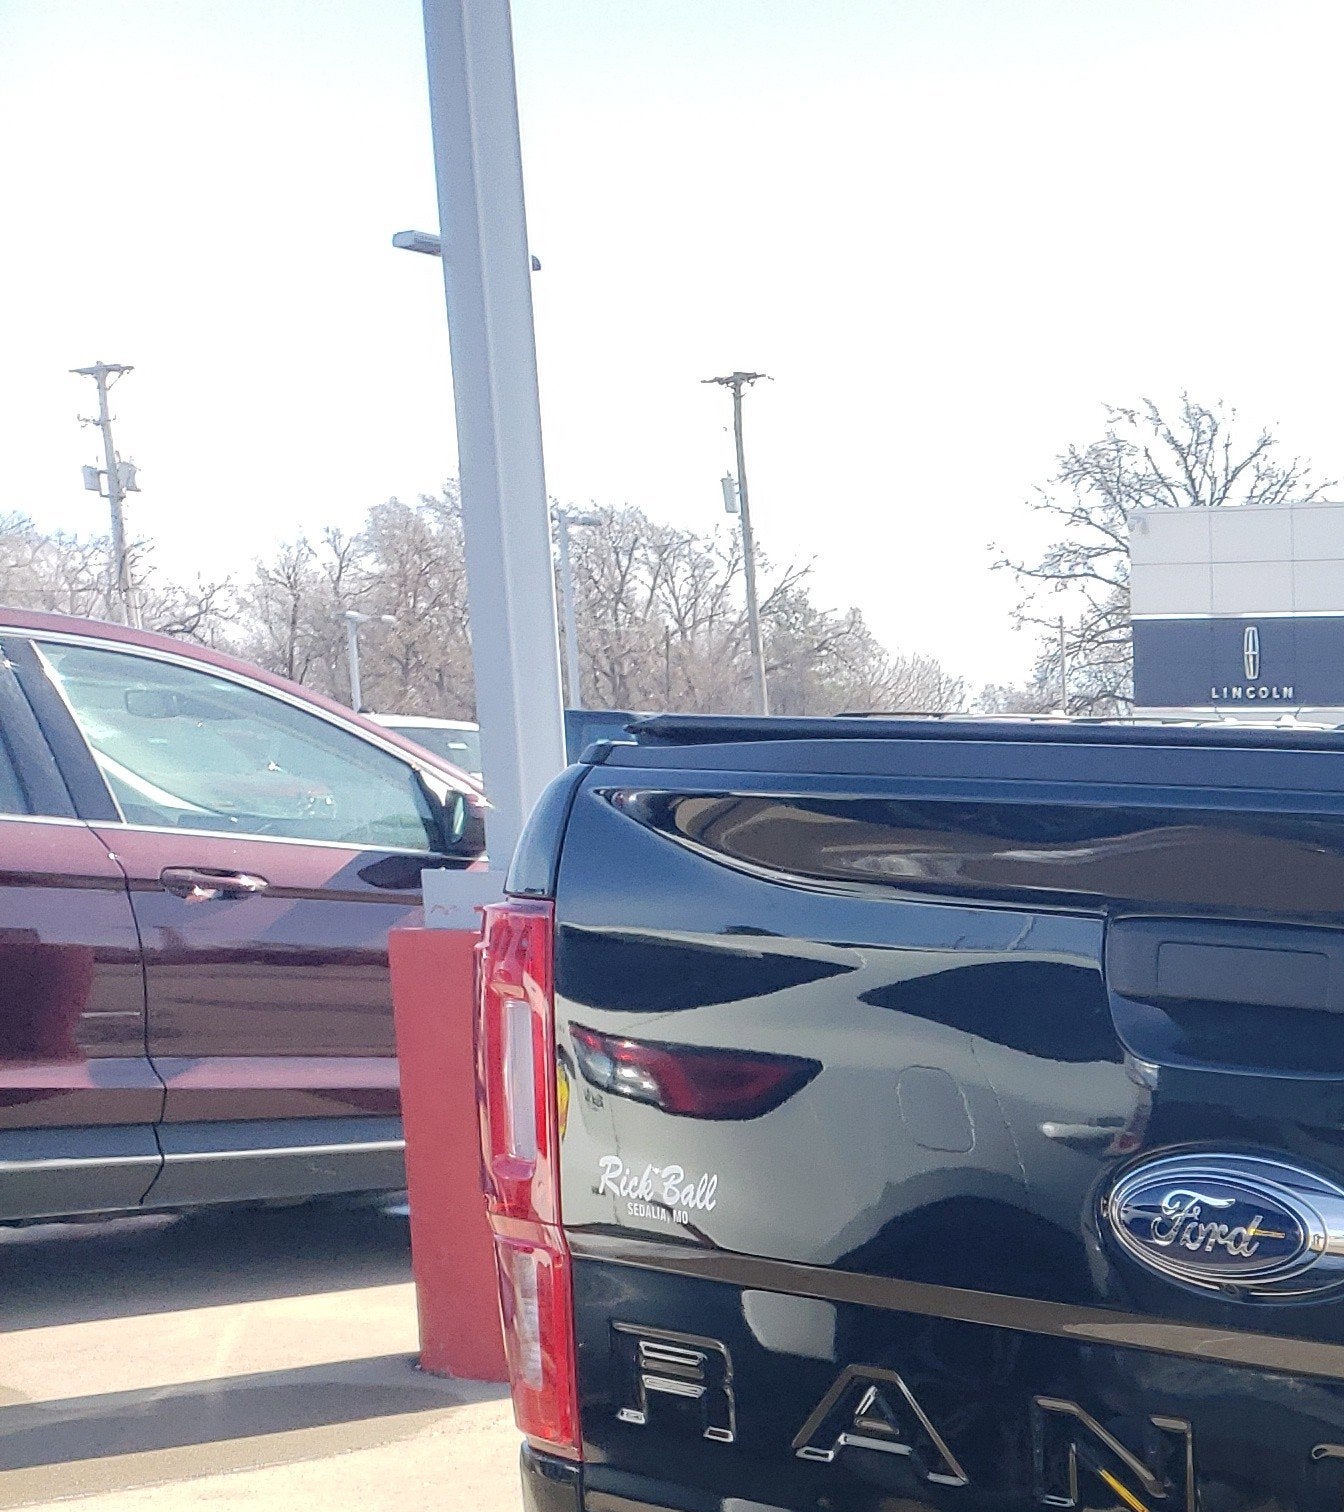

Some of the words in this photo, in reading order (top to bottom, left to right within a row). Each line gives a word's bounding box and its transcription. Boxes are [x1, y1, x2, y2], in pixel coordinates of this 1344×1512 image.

[1211, 686, 1294, 700] LINCOLN
[599, 1155, 654, 1202] Rick
[661, 1165, 718, 1211] Ball
[627, 1202, 670, 1224] SEDALIA,
[673, 1210, 689, 1224] MO
[1150, 1188, 1263, 1258] Ford
